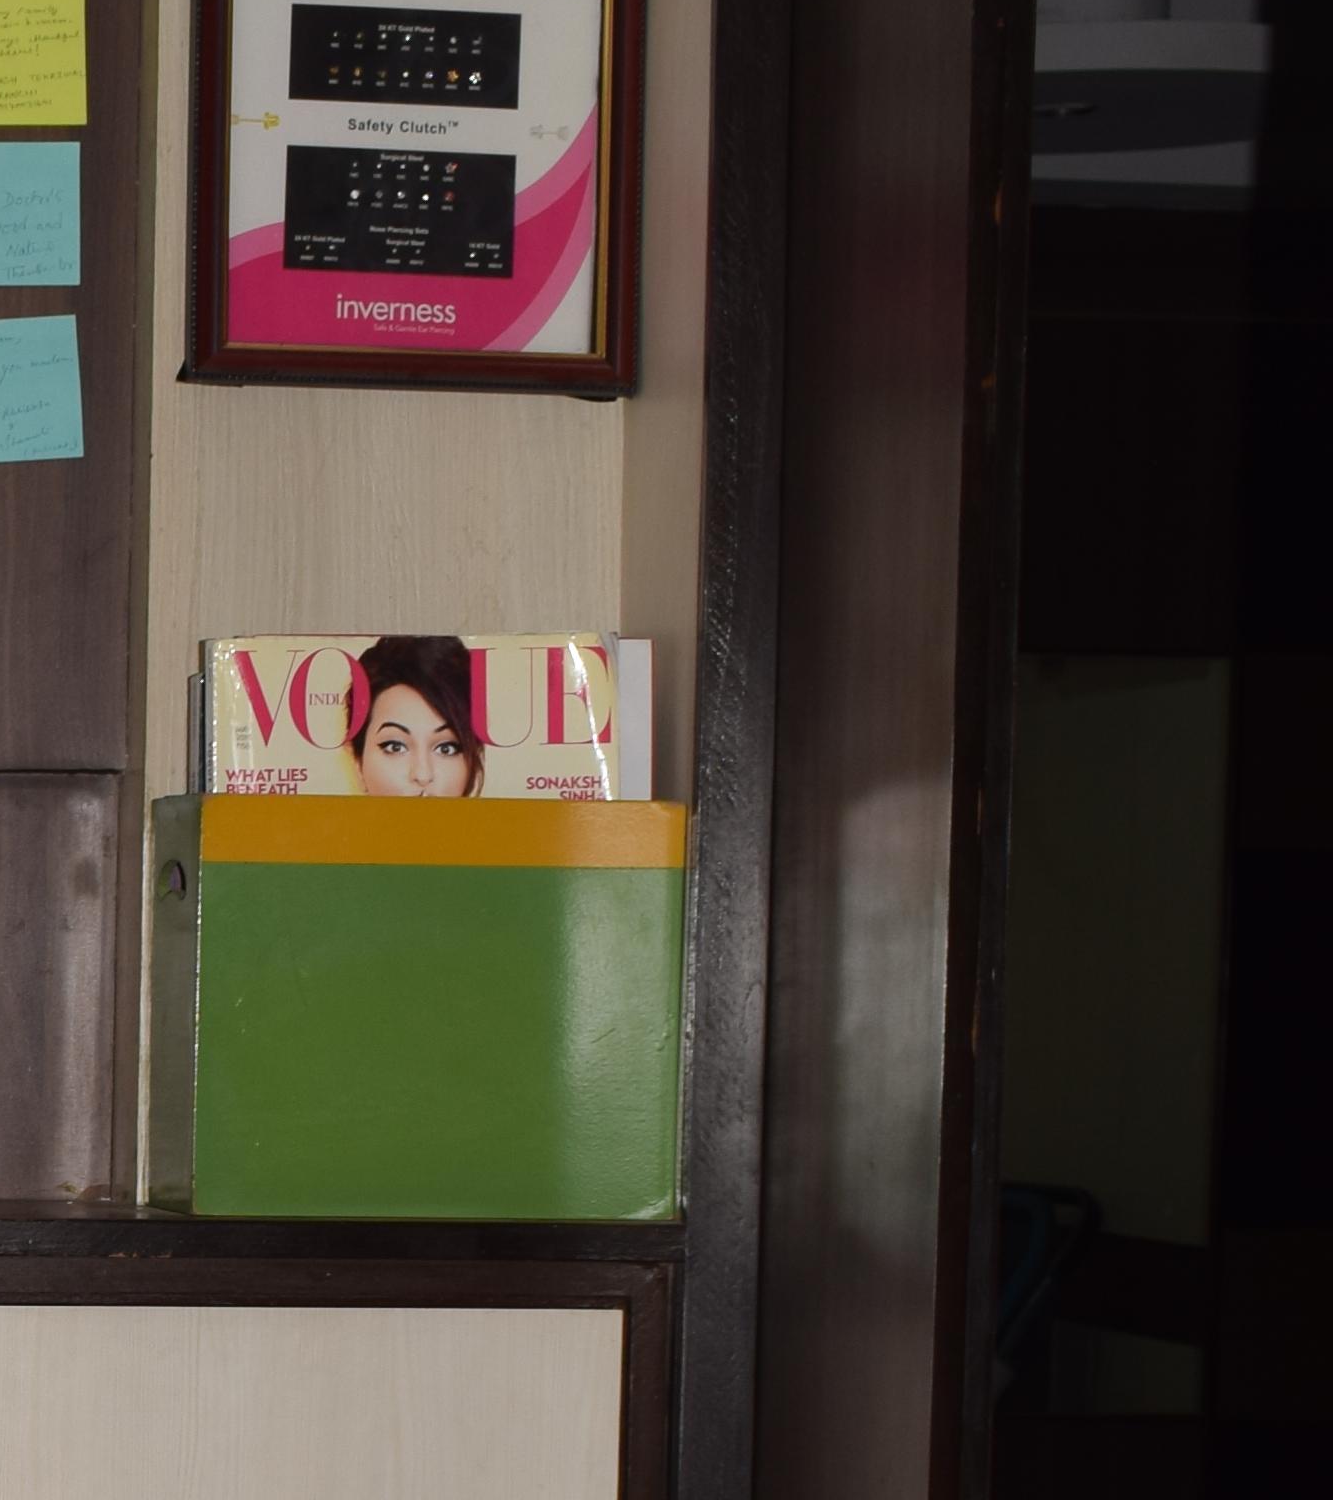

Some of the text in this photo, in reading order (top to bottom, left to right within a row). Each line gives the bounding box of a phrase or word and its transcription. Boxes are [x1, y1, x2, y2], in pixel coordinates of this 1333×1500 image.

[348, 118, 395, 134] Safety
[335, 293, 457, 324] inverness
[228, 645, 613, 748] VOUE
[308, 692, 347, 706] INDI
[225, 768, 309, 783] WHAT LIES
[526, 776, 606, 790] SONAKSH
[225, 783, 298, 795] BENEATH
